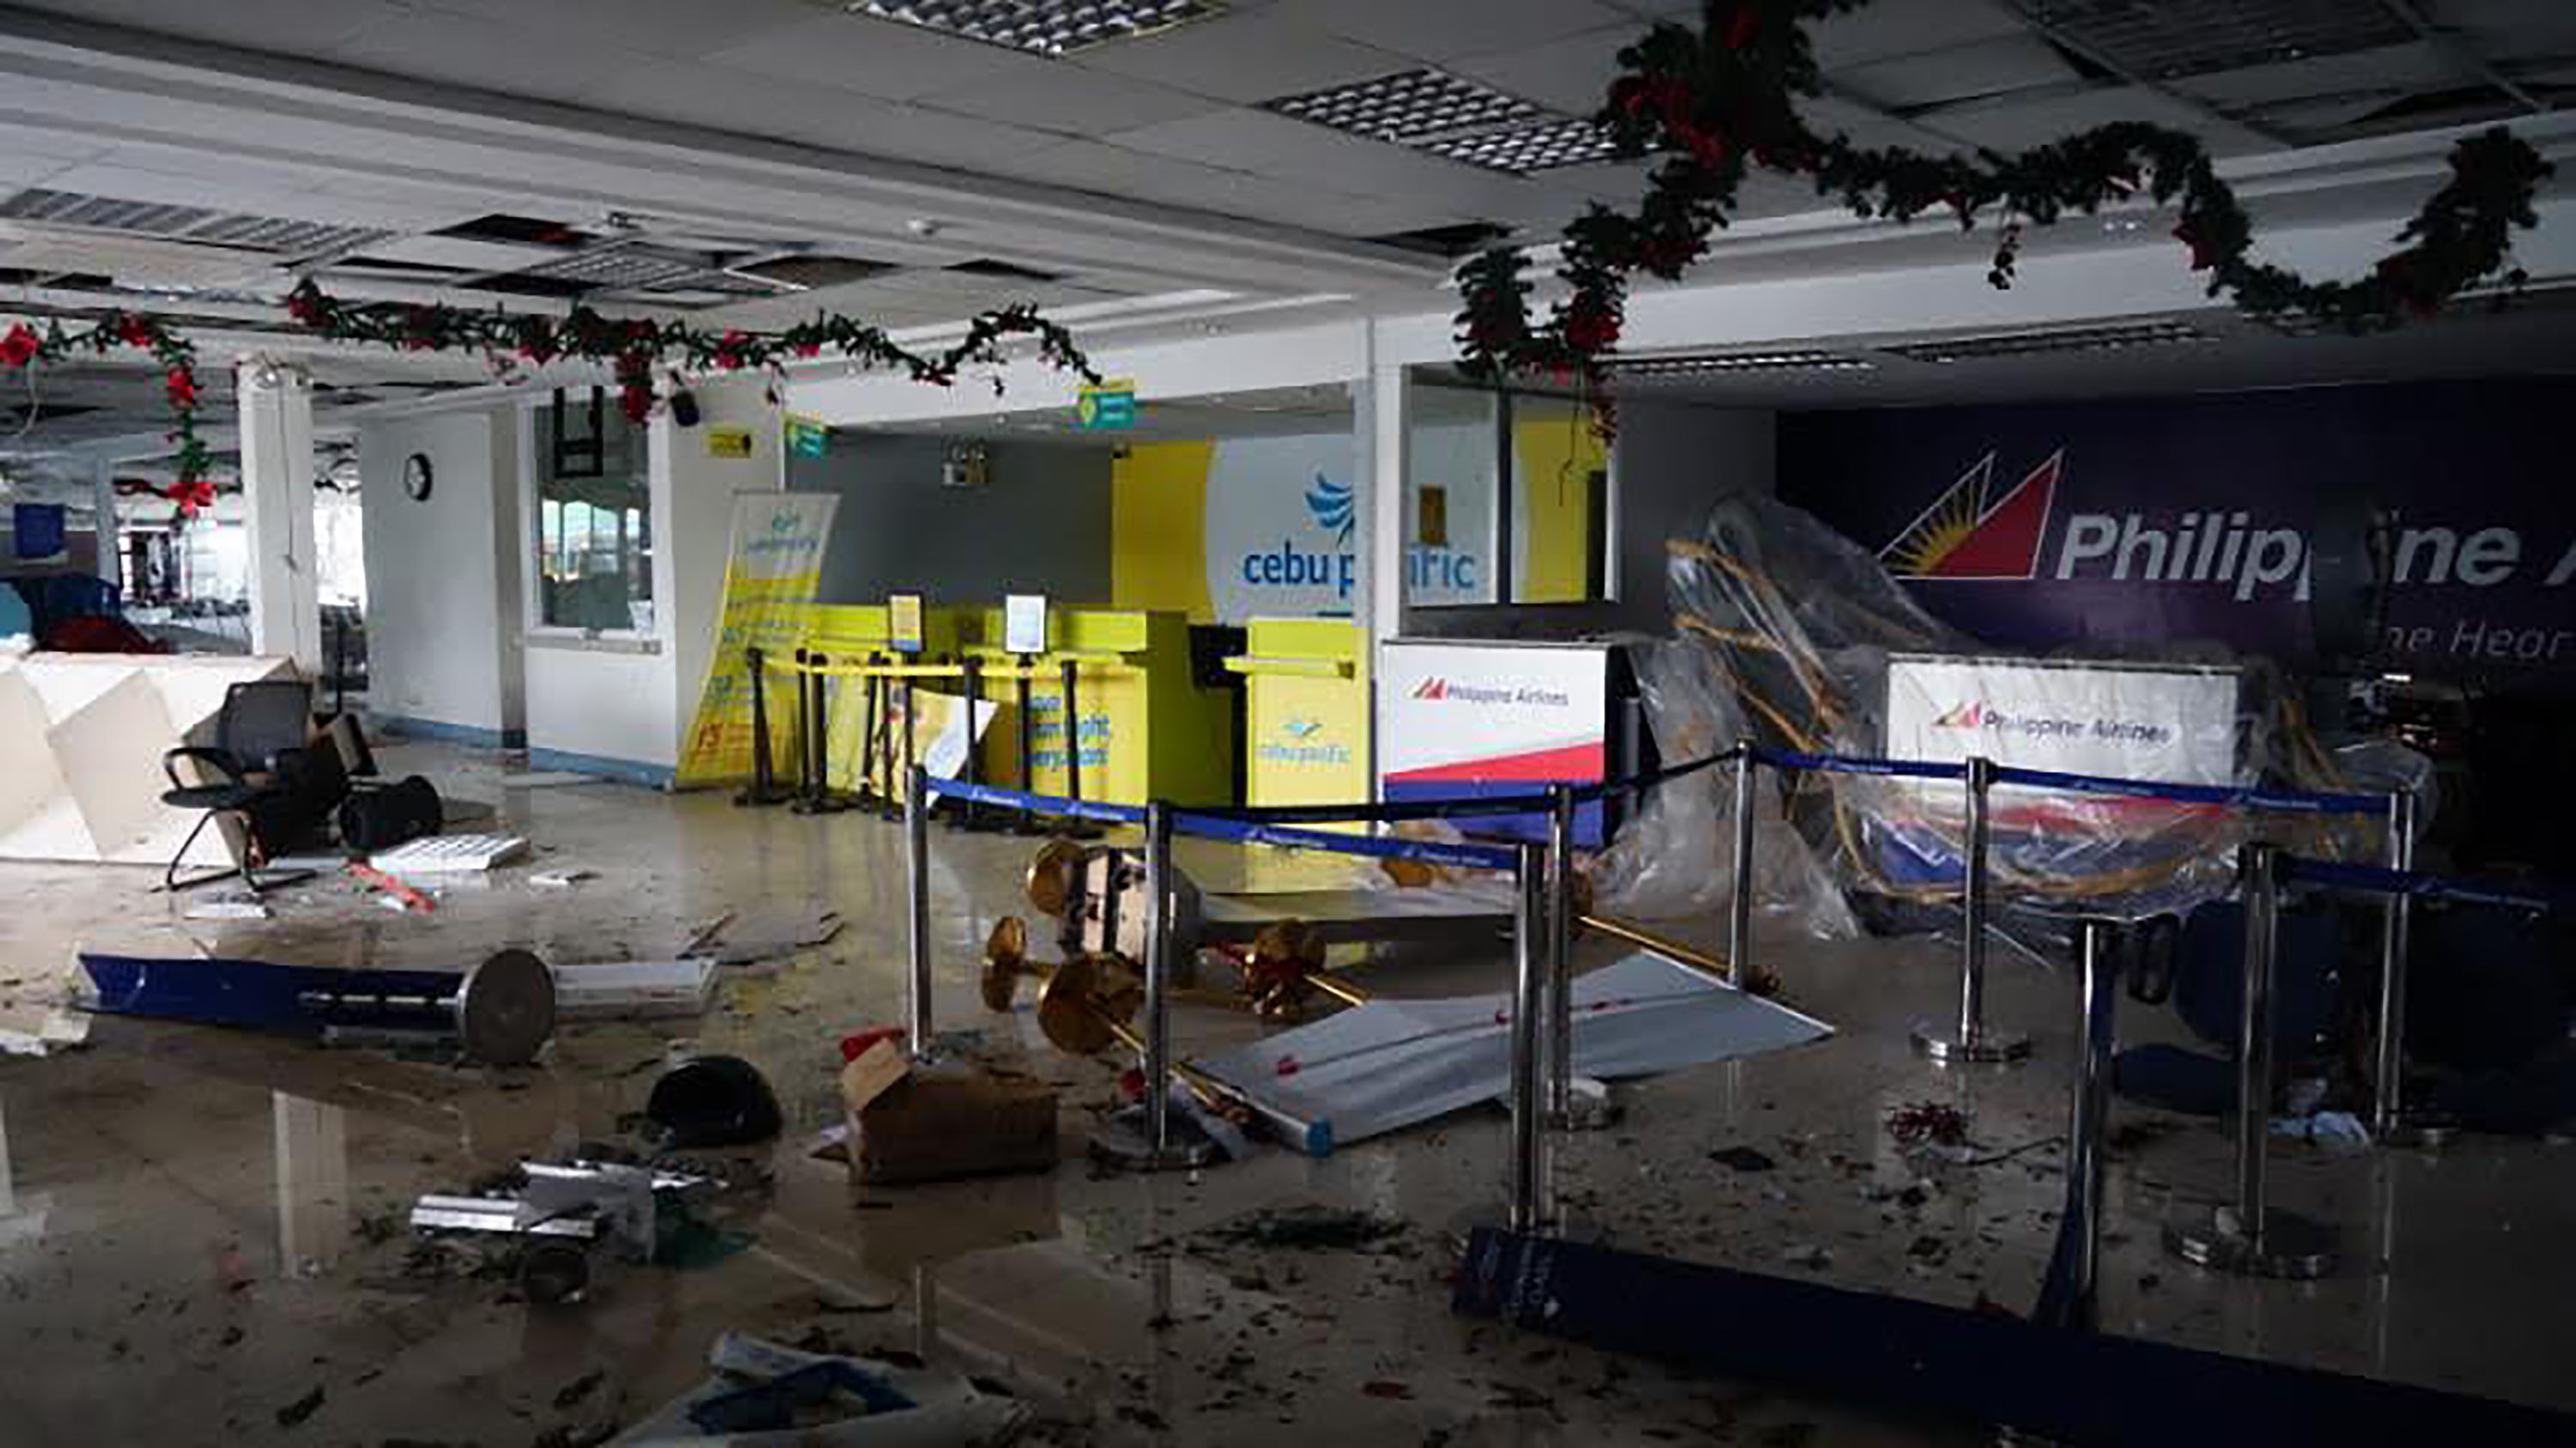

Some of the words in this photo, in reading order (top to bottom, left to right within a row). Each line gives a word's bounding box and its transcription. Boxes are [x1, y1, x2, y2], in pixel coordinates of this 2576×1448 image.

[1244, 538, 1328, 585] cebu
[2055, 510, 2521, 601] Philipne
[1984, 709, 2084, 741] Philippine
[2093, 719, 2171, 743] Airlines
